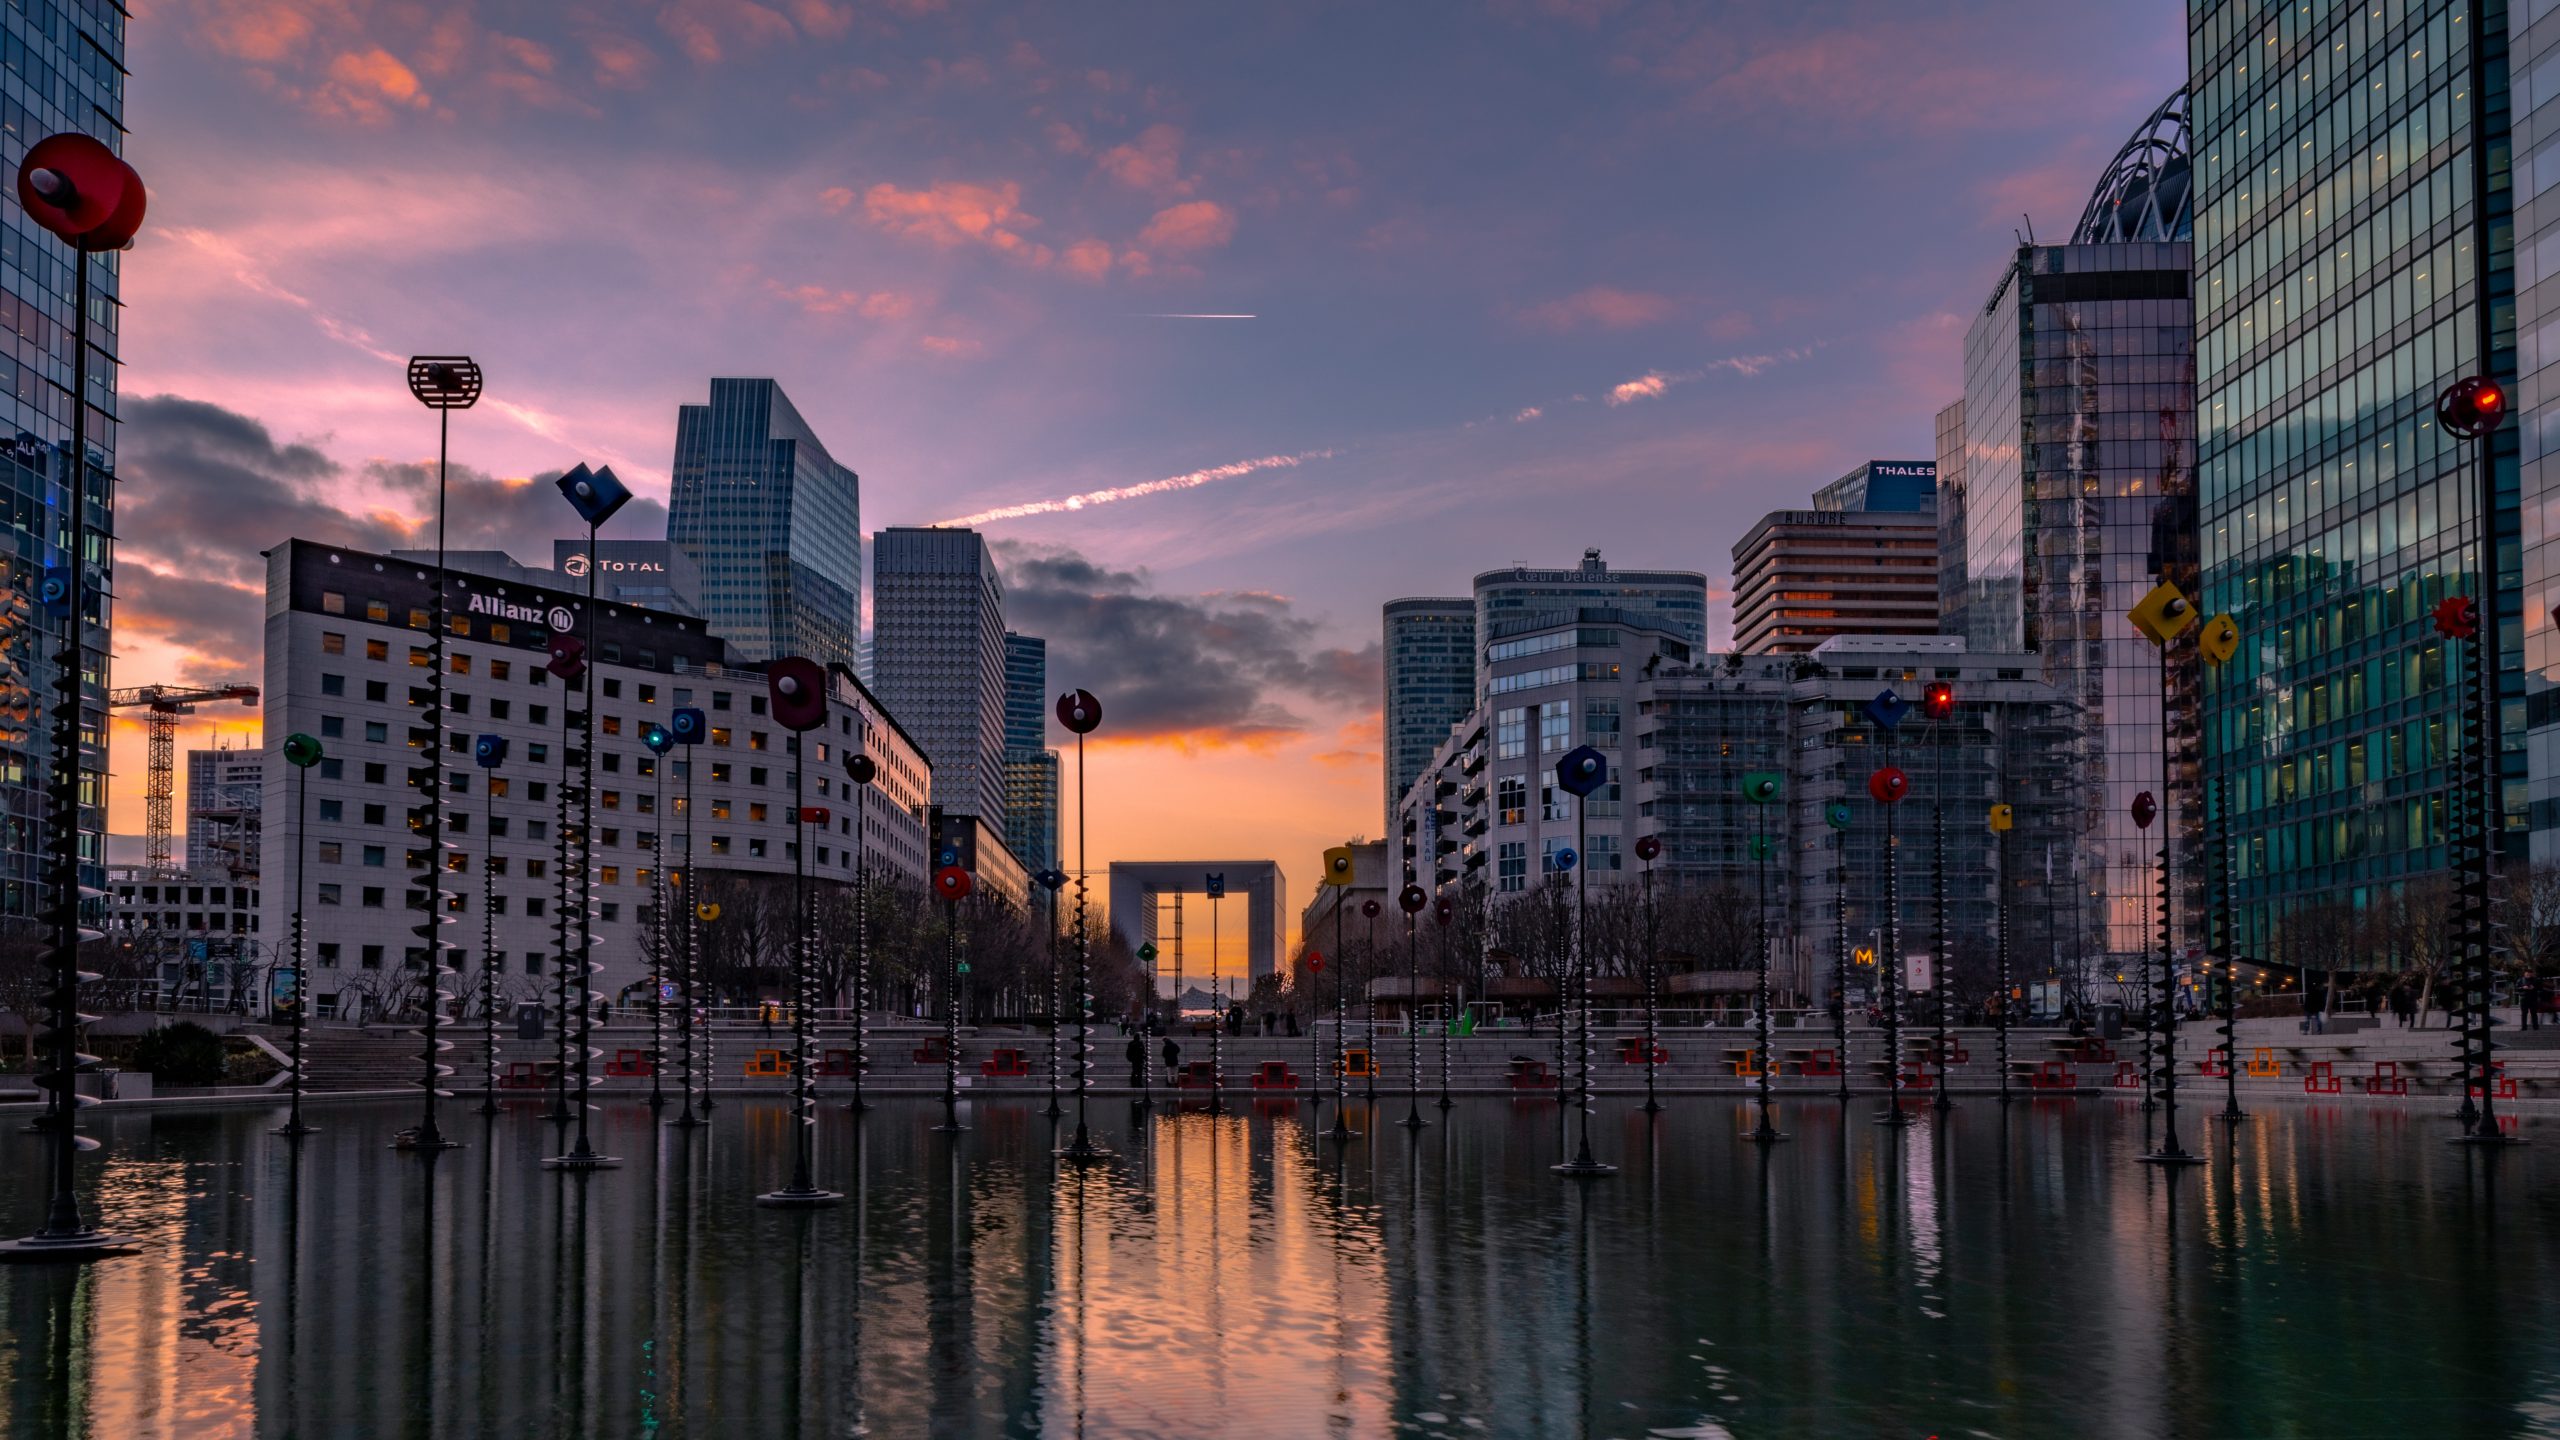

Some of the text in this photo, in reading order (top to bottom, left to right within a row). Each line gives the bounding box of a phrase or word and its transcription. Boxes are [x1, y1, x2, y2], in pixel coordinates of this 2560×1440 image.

[1876, 466, 1936, 476] THALES
[1785, 511, 1847, 525] AURORE
[599, 559, 665, 572] TOTAL
[468, 593, 544, 624] Allianz
[1855, 947, 1874, 965] M
